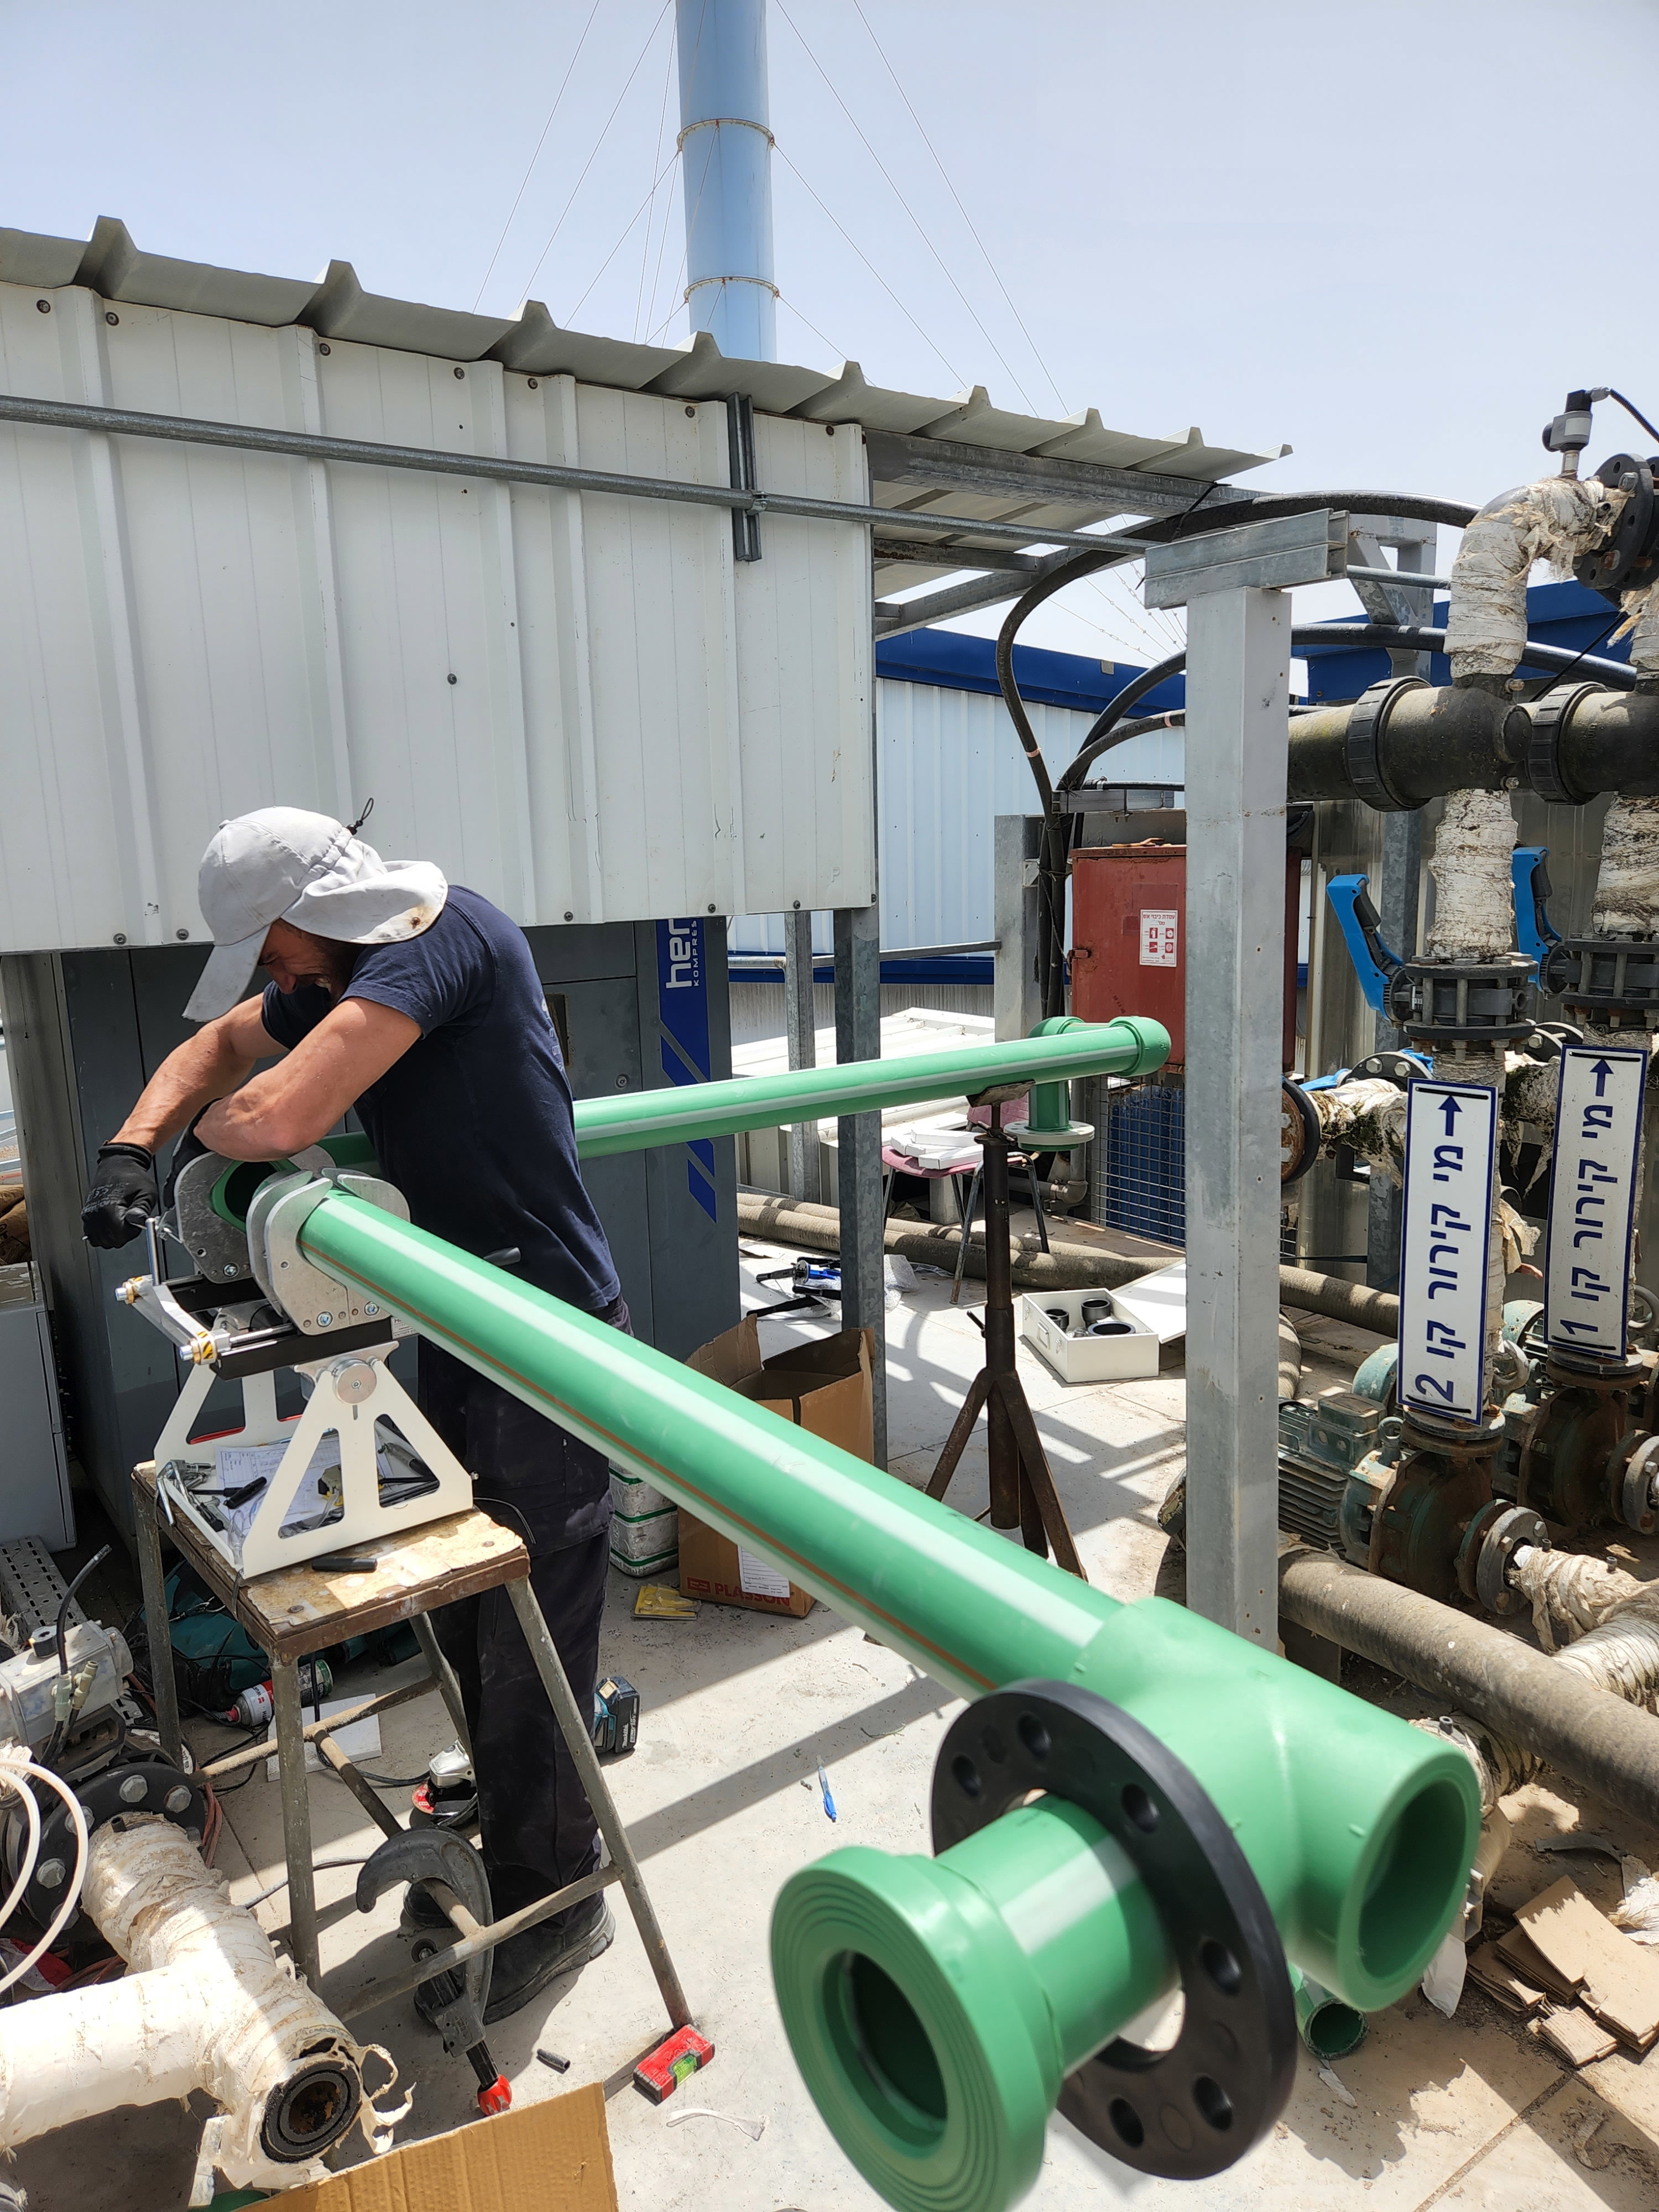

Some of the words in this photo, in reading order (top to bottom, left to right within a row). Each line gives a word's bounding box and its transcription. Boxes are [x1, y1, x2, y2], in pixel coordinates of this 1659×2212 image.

[1582, 1104, 1613, 1139] מי
[1433, 1145, 1463, 1182] מי
[1574, 1159, 1618, 1248] קירור
[1428, 1203, 1471, 1300] קירור
[1571, 1266, 1610, 1301] קו
[1426, 1319, 1466, 1359] קו
[1559, 1319, 1598, 1333] 1
[1415, 1374, 1453, 1403] 2
[714, 1582, 790, 1606] PLASSON
